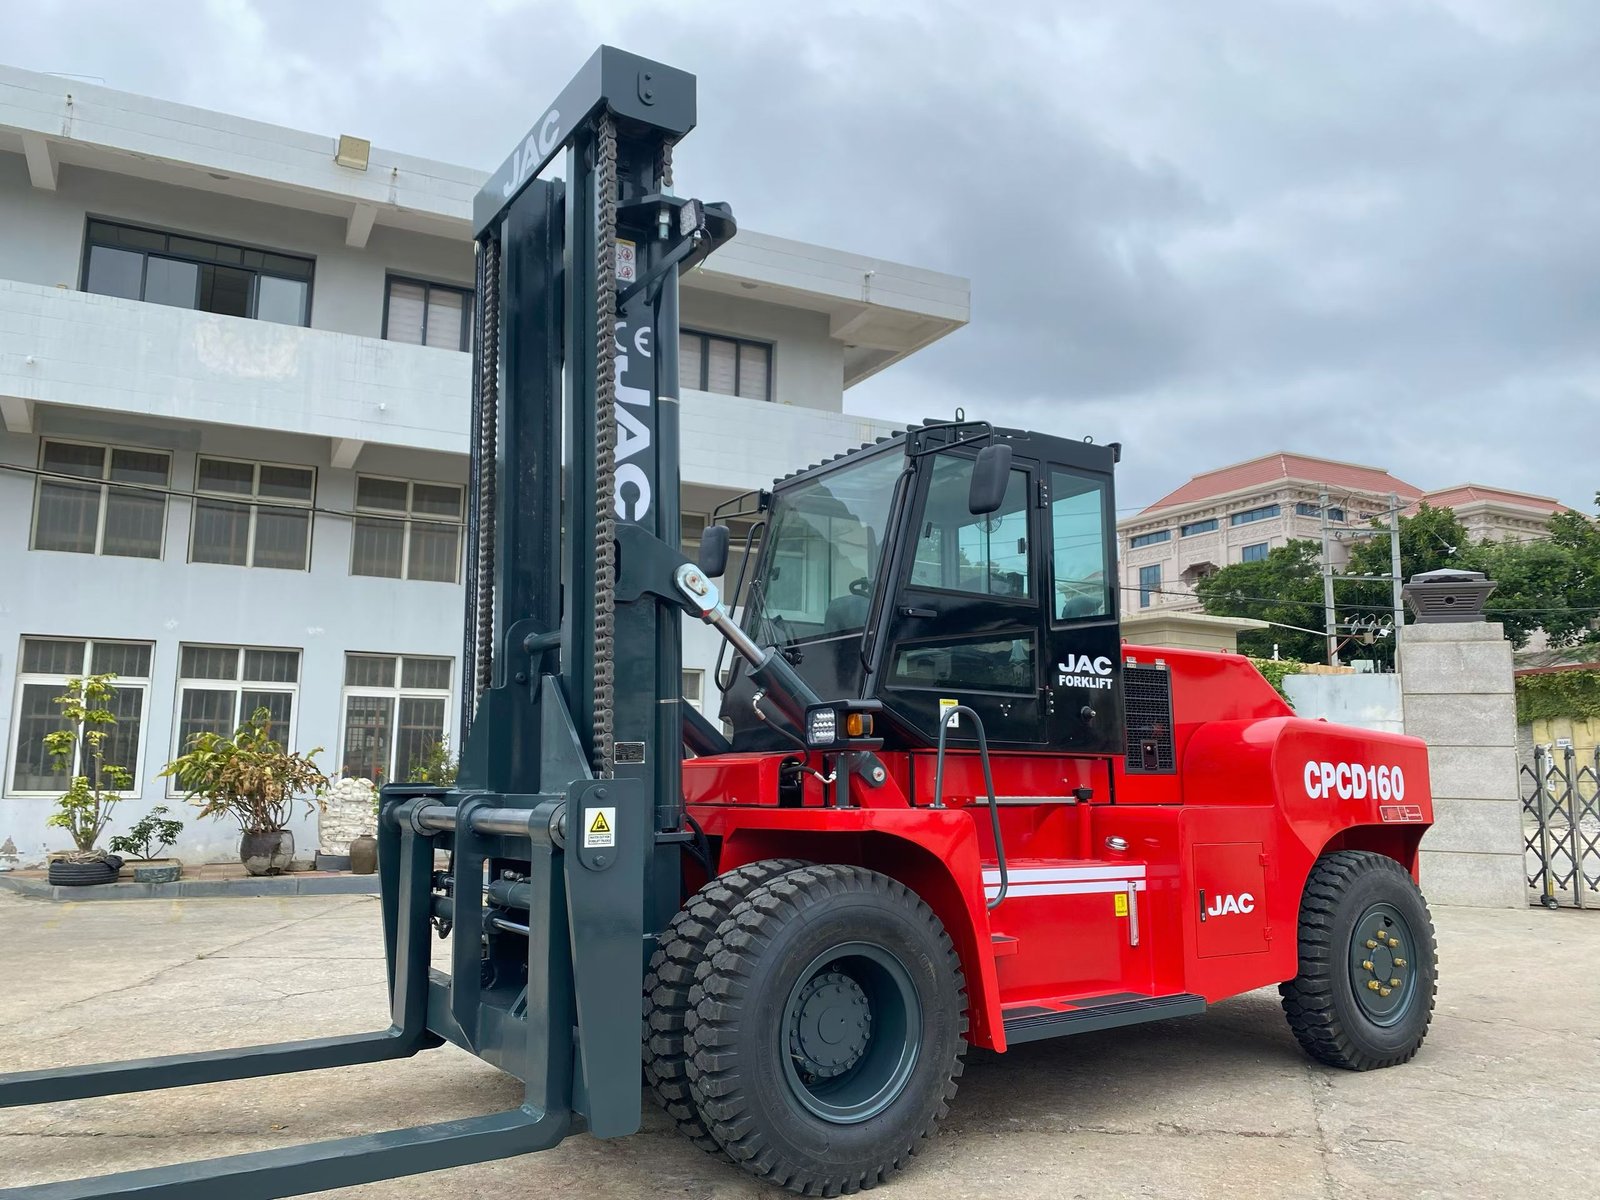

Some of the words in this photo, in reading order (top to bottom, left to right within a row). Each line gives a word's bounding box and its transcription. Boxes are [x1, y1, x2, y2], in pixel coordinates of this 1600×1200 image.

[503, 110, 560, 197] JAC
[613, 355, 650, 522] JAC
[1058, 654, 1112, 675] JAC
[1059, 675, 1113, 689] FORKLIFT
[1304, 761, 1405, 801] CPCD160
[1208, 893, 1254, 916] JAC
